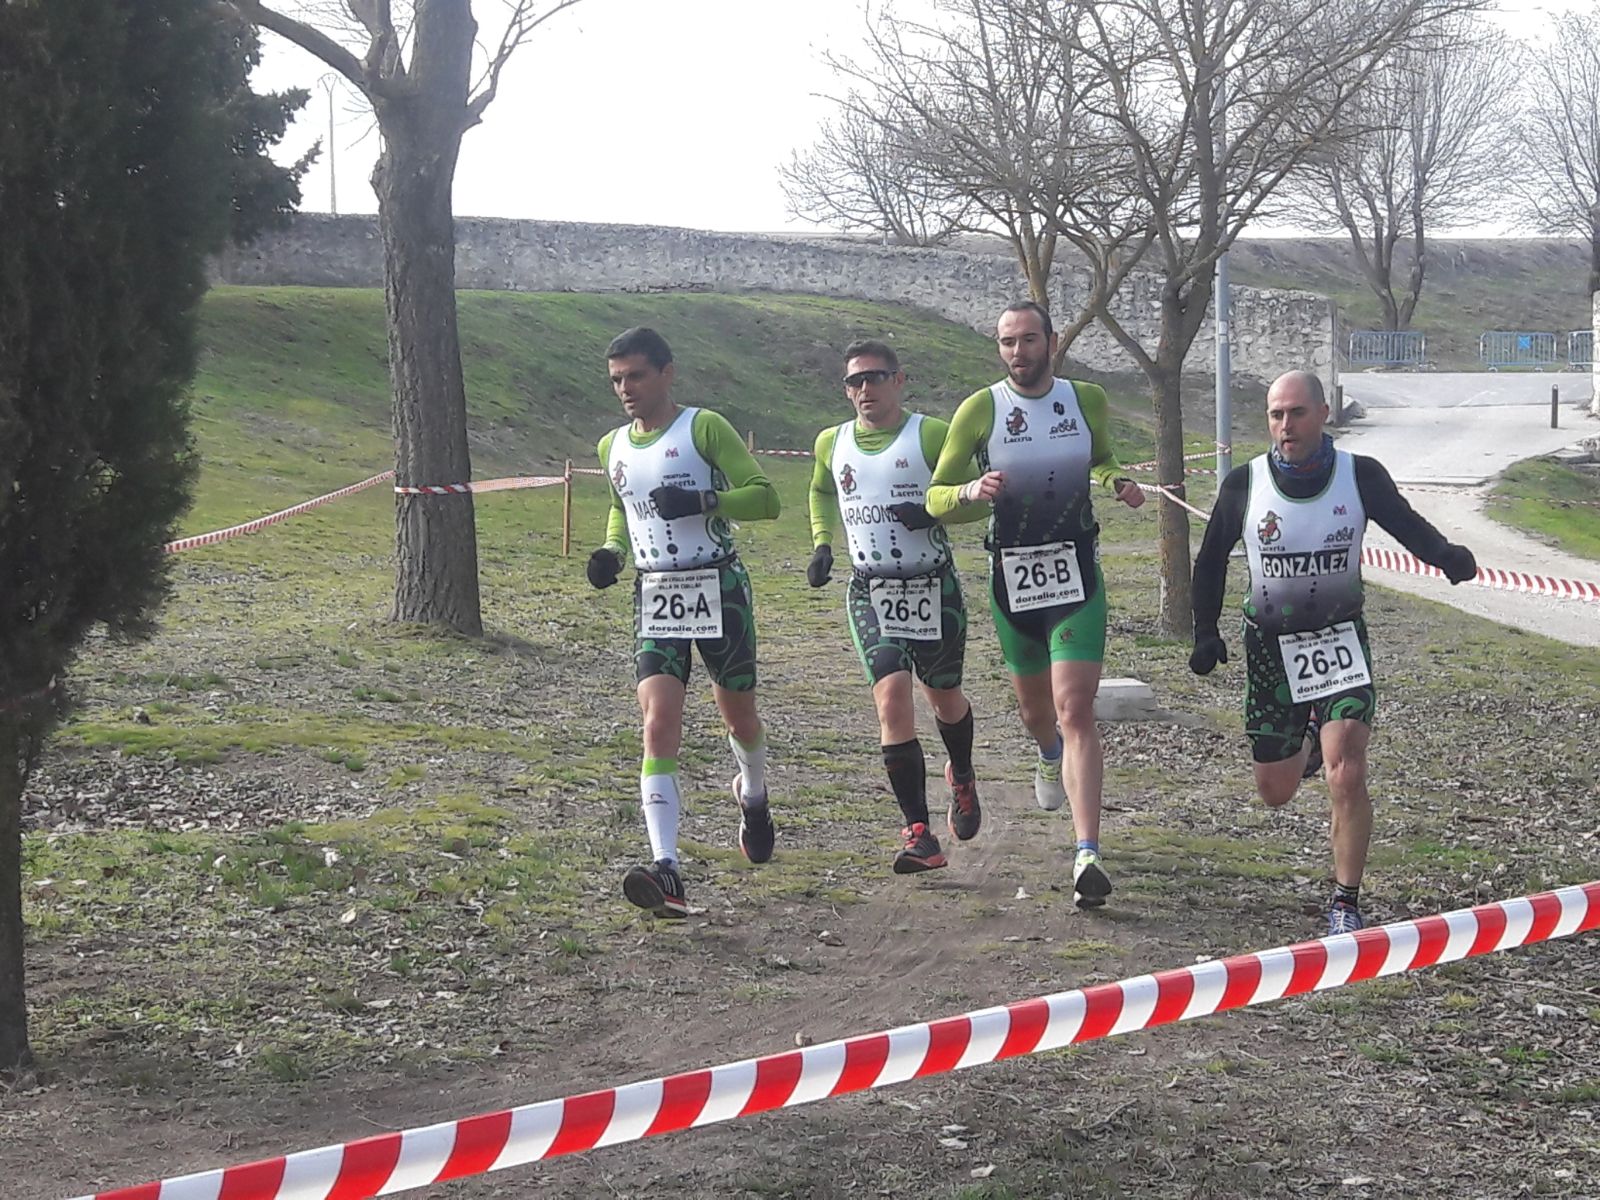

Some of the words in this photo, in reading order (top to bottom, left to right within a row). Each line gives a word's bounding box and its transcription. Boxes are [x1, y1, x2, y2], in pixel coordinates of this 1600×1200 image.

[890, 489, 923, 498] Lacerta
[1014, 558, 1071, 591] 26-B
[652, 592, 711, 620] 26-A
[1015, 588, 1079, 604] dorsalia.com
[880, 597, 931, 622] 26-C
[648, 624, 718, 632] dorsalia.com
[1293, 645, 1353, 680] 26-D
